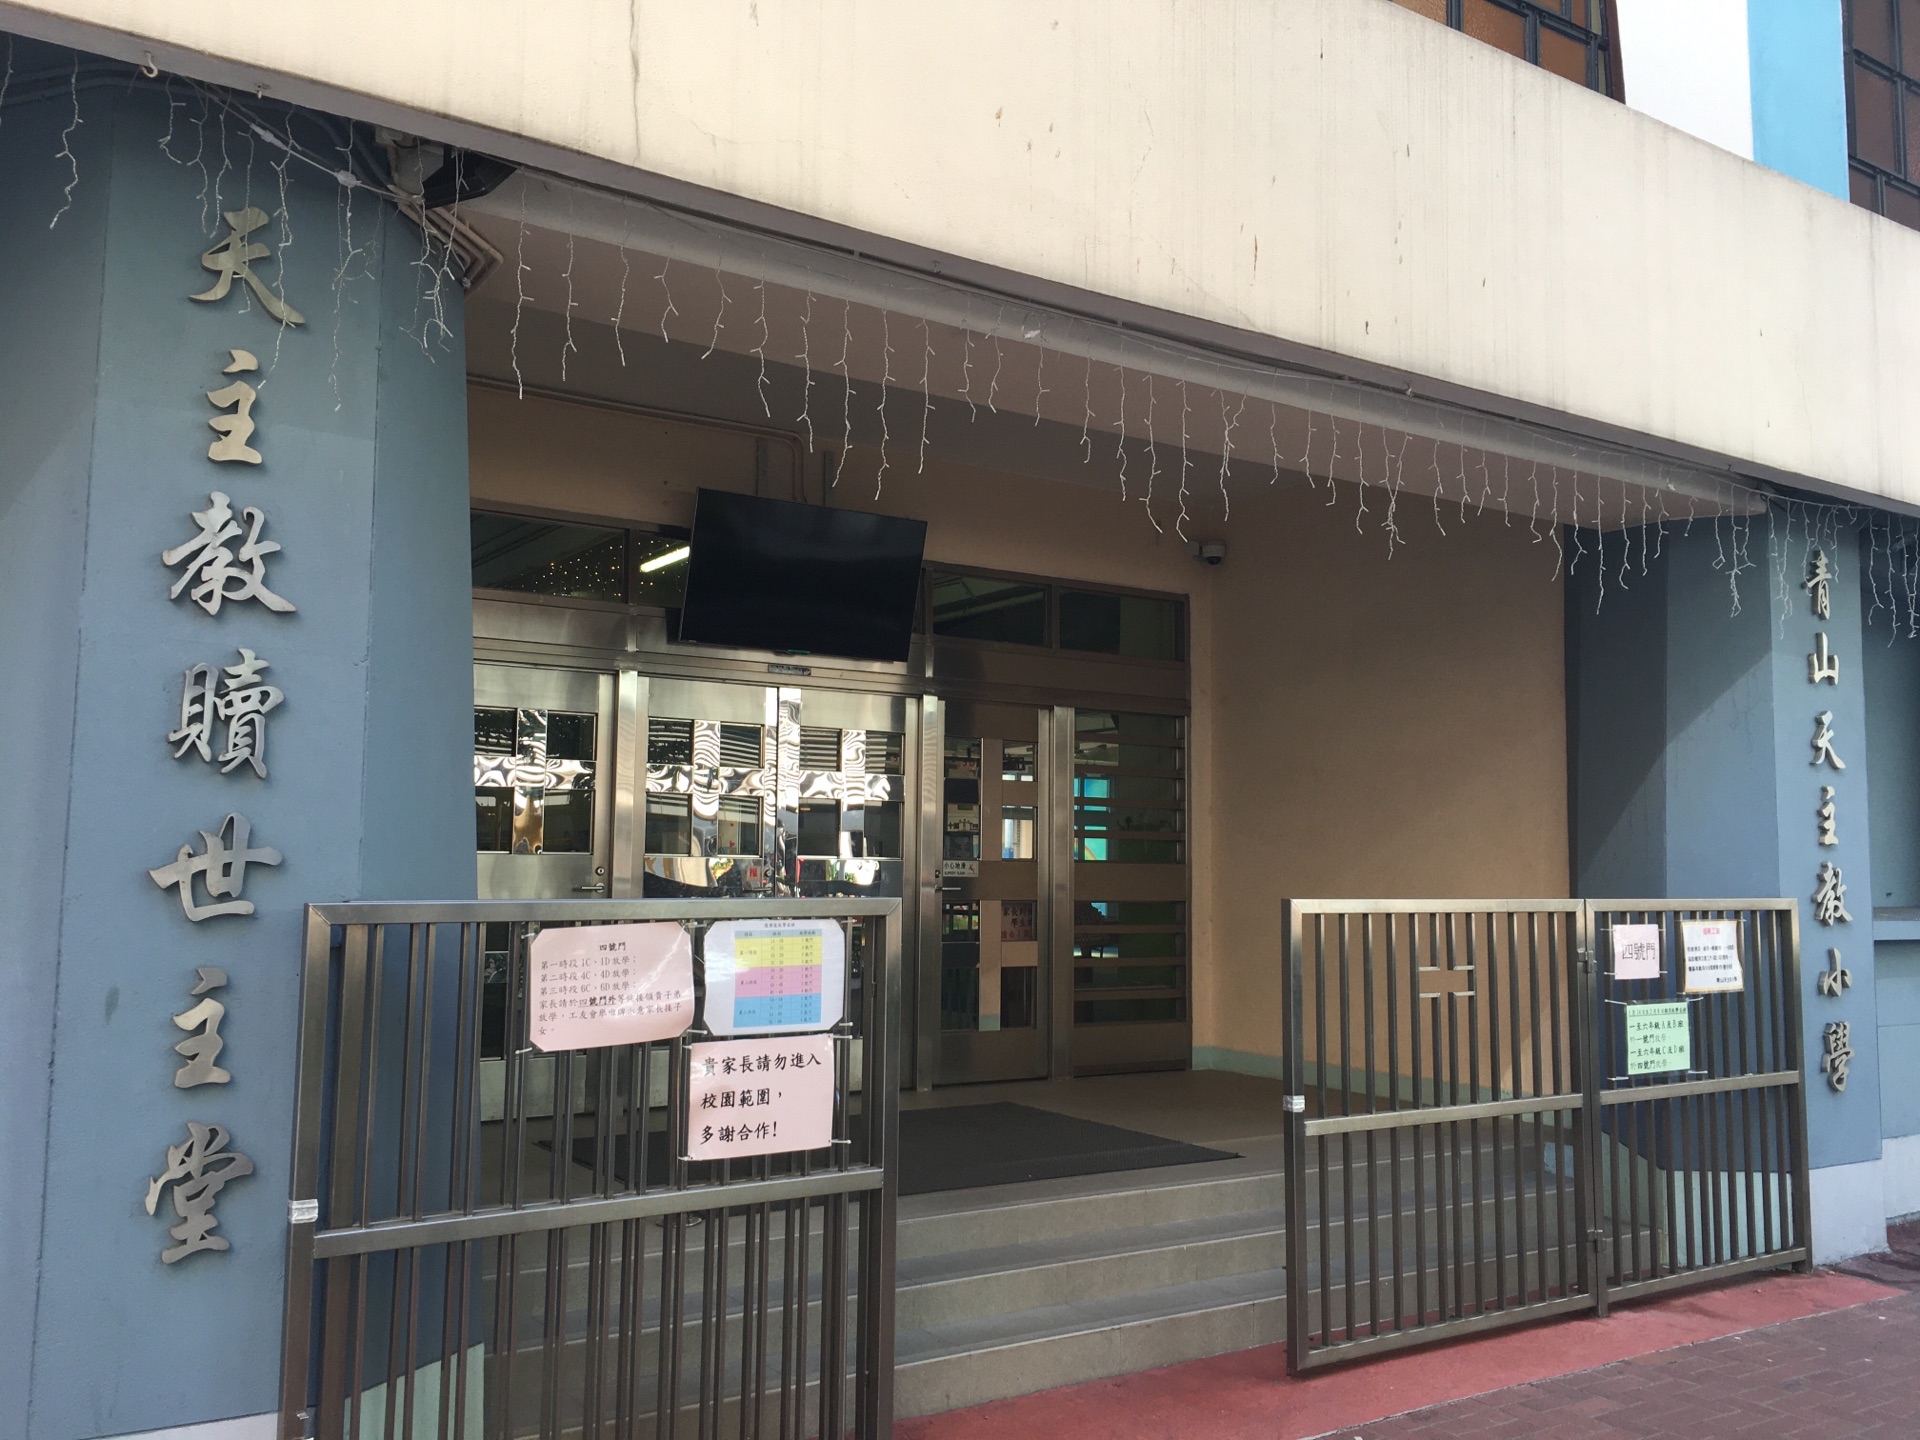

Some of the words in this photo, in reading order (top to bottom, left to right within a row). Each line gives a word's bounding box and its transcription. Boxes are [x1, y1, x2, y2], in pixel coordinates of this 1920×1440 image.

[145, 207, 305, 1266] 天主教贖世主堂
[1803, 549, 1856, 1093] 青山天主教小學
[599, 941, 626, 951] 四號門
[1622, 942, 1656, 960] 四號門
[702, 1052, 822, 1076] 貴家長請勿進入
[700, 1087, 782, 1109] 校園範圍，
